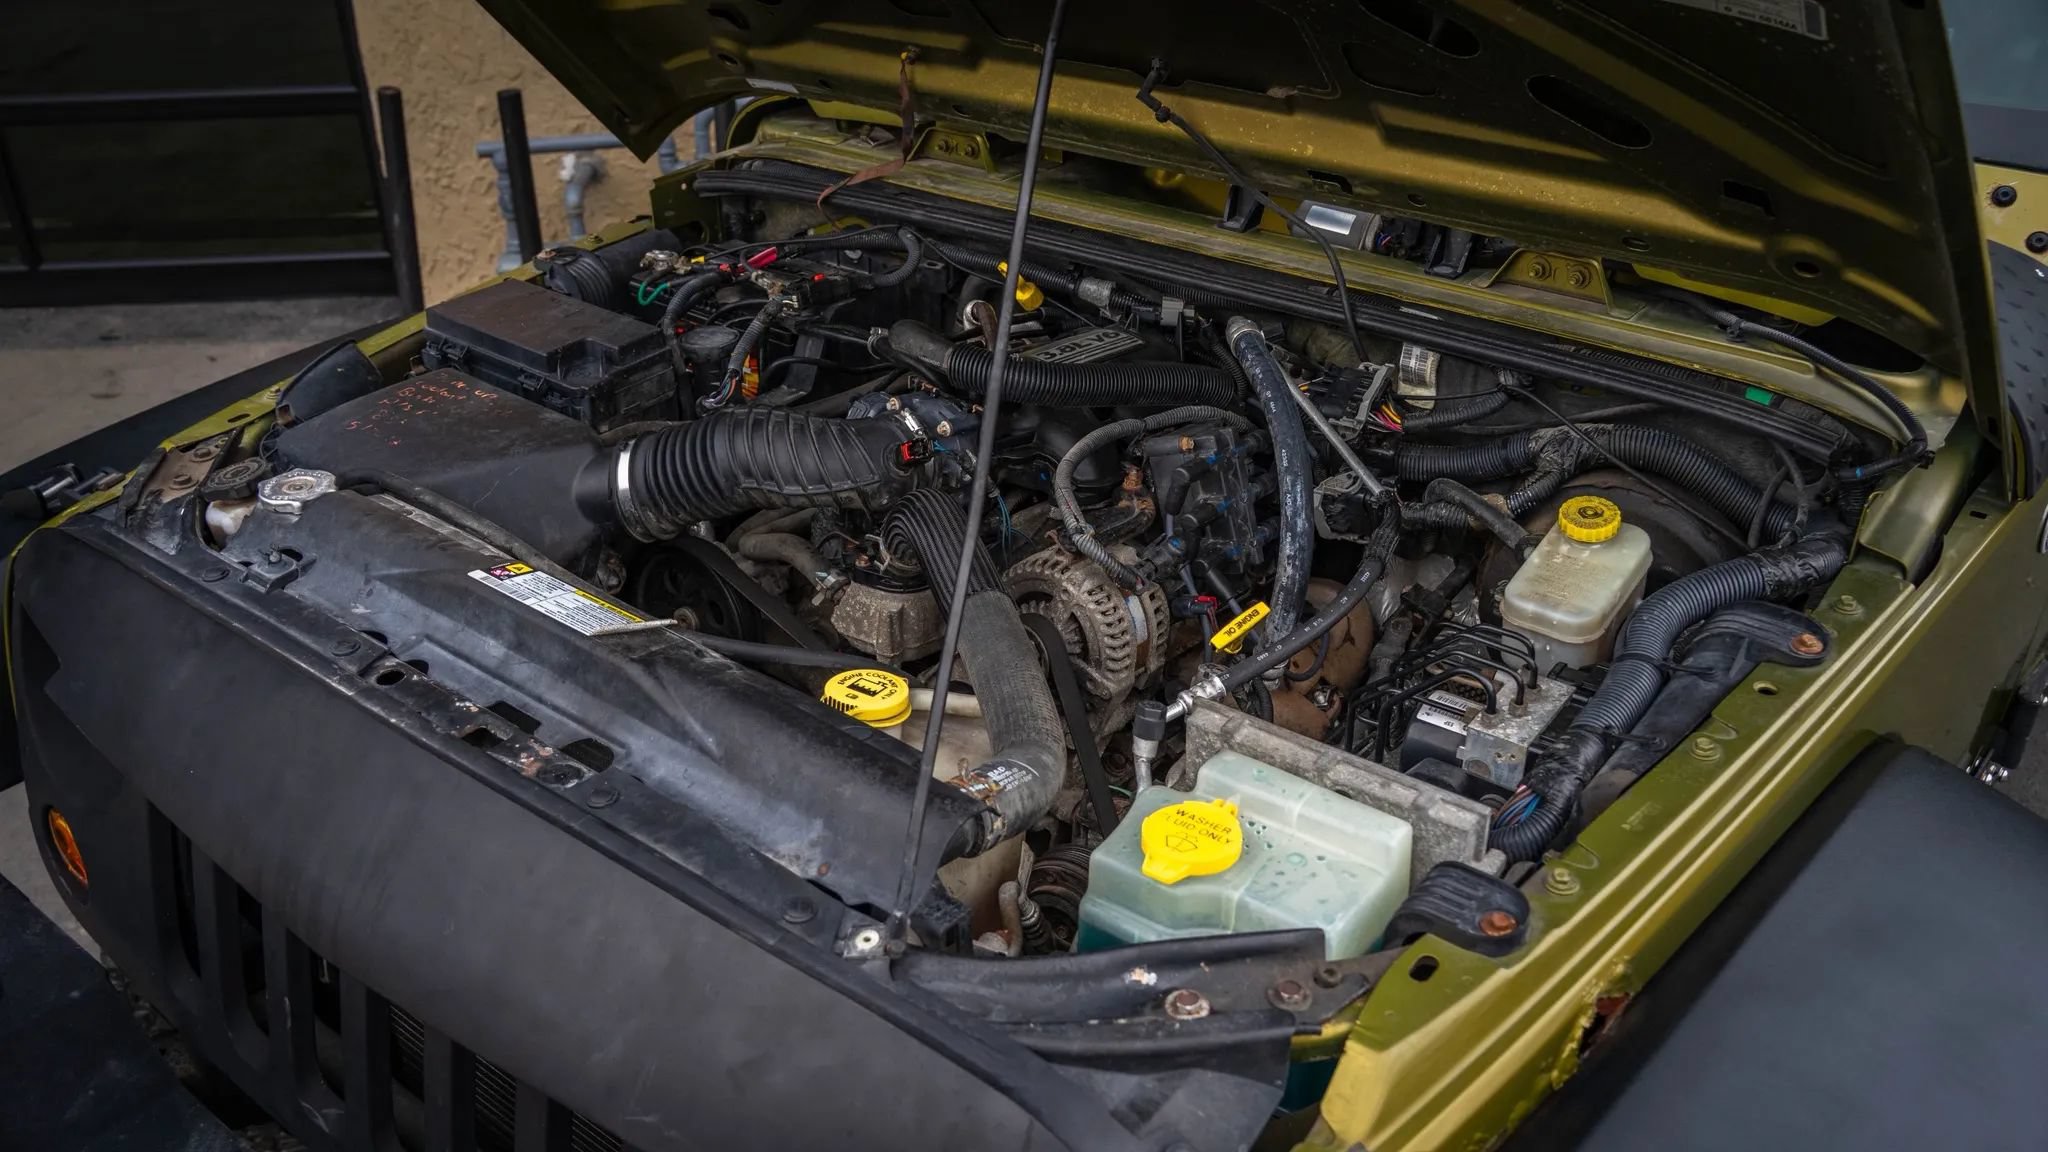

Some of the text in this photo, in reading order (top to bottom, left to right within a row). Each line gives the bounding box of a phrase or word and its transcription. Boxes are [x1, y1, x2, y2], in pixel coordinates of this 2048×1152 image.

[1086, 331, 1121, 344] V6
[1223, 608, 1260, 637] ENGINE OIL
[837, 672, 899, 700] ENGINE COOLANT ONLY
[1164, 814, 1233, 844] UID ONLY
[1175, 808, 1232, 834] WASHER
